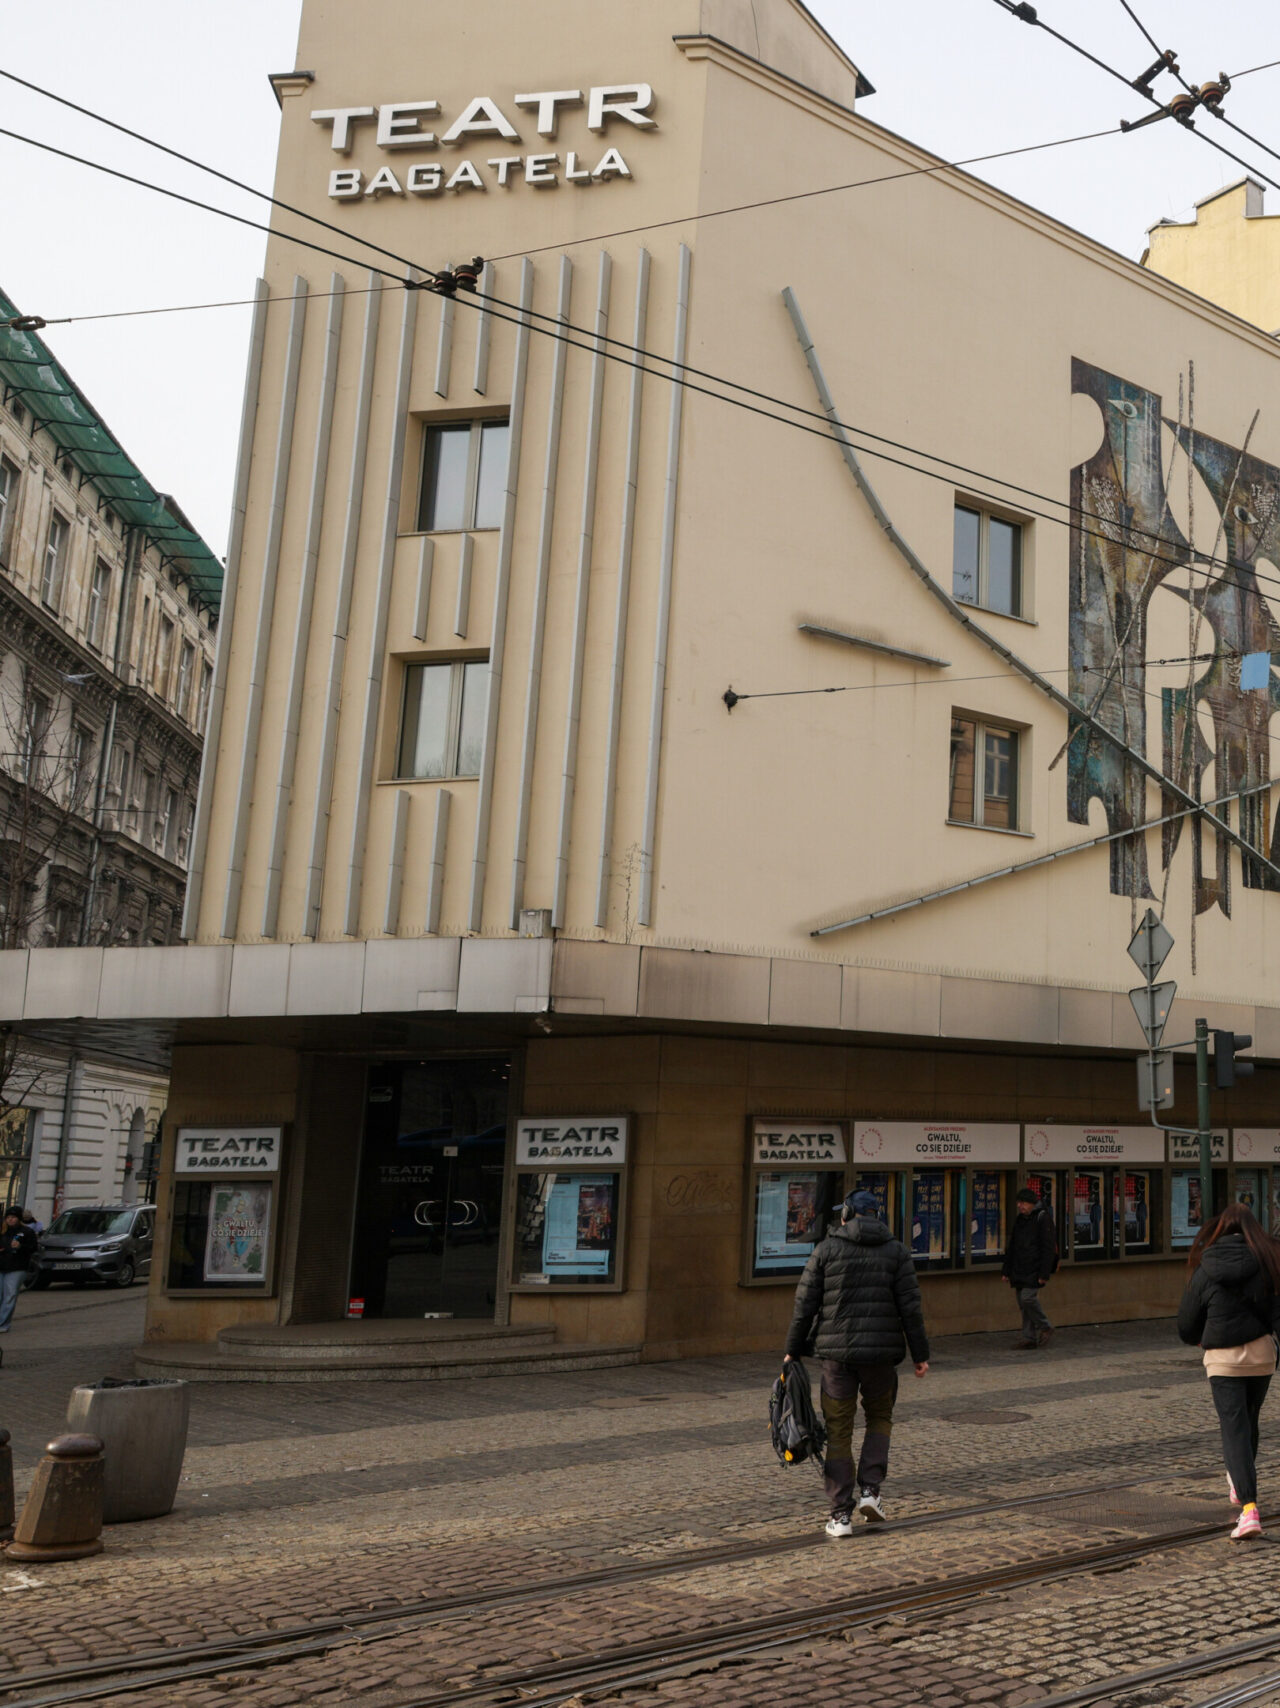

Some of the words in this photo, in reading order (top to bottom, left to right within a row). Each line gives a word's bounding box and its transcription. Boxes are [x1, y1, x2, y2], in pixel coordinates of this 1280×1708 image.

[310, 82, 659, 153] TEATR
[327, 147, 633, 201] BAGATELA
[522, 1126, 620, 1142] TEATR
[754, 1132, 836, 1146] TEATR
[928, 1133, 962, 1143] GWAŁTU,
[1086, 1135, 1116, 1144] GWAŁTU,
[182, 1137, 274, 1152] TEATR
[1171, 1136, 1224, 1146] TEAR
[528, 1146, 613, 1158] BAGATELA
[760, 1149, 834, 1160] BAGATELA
[916, 1144, 928, 1152] CO
[930, 1144, 942, 1155] SIĘ
[943, 1144, 972, 1152] DZIEJE!
[1088, 1145, 1098, 1155] SIĘ
[1099, 1145, 1124, 1153] DZIEJE!
[187, 1156, 268, 1168] BAGATELA
[378, 1165, 434, 1175] TEATR
[212, 1229, 224, 1237] CO
